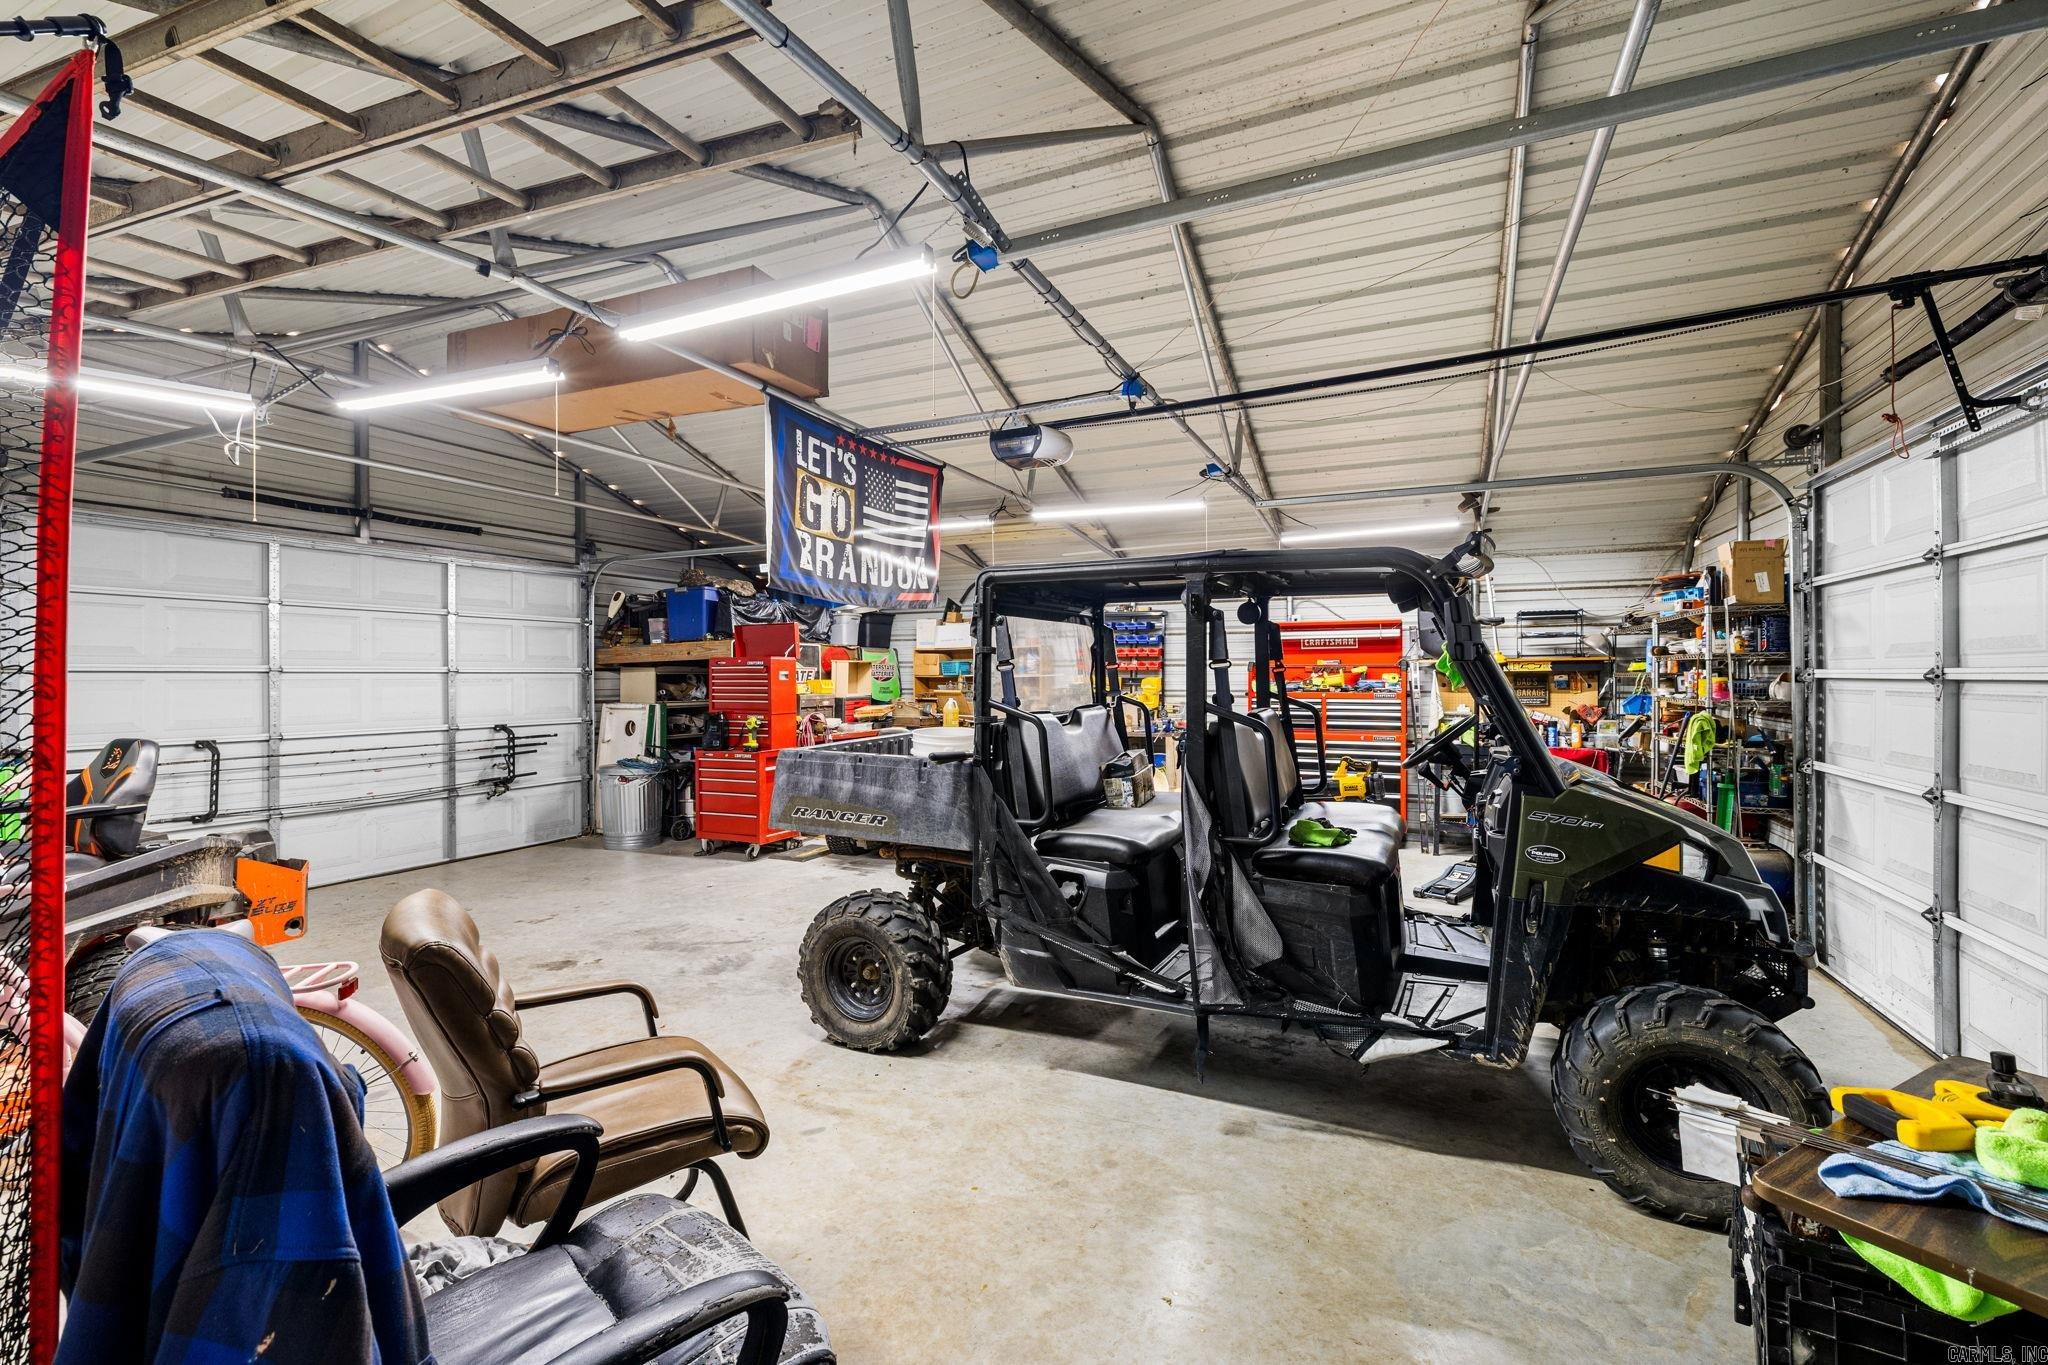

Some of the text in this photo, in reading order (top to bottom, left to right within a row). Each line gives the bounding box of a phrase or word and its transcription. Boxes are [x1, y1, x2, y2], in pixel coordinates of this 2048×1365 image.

[796, 429, 857, 486] LET'S
[799, 473, 852, 539] GO
[798, 531, 929, 590] BRANDON
[1304, 638, 1356, 646] CRAFTSMAN
[1516, 688, 1546, 697] GARAGE
[791, 806, 889, 827] RANGER
[1527, 810, 1583, 827] 570
